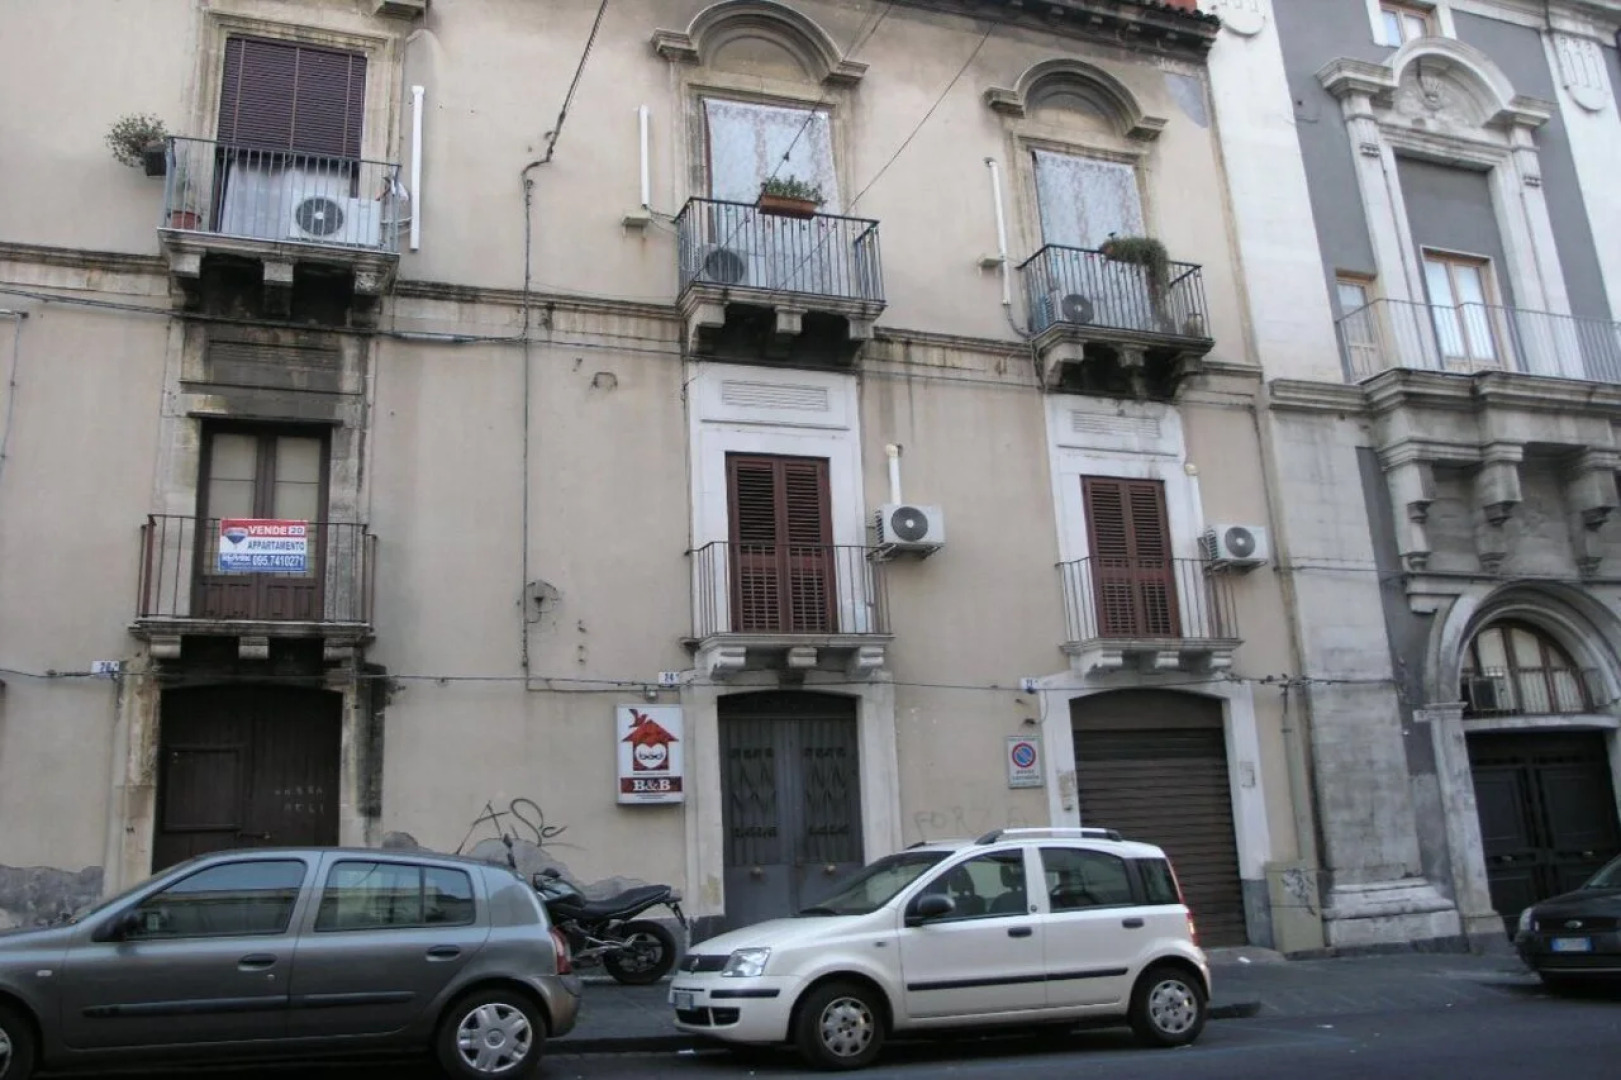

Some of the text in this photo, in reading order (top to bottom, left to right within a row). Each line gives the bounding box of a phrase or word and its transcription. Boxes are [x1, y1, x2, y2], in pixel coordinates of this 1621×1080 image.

[248, 541, 304, 551] APPARTAMENTO
[252, 555, 304, 567] 095.7410271
[633, 779, 671, 791] B&B
